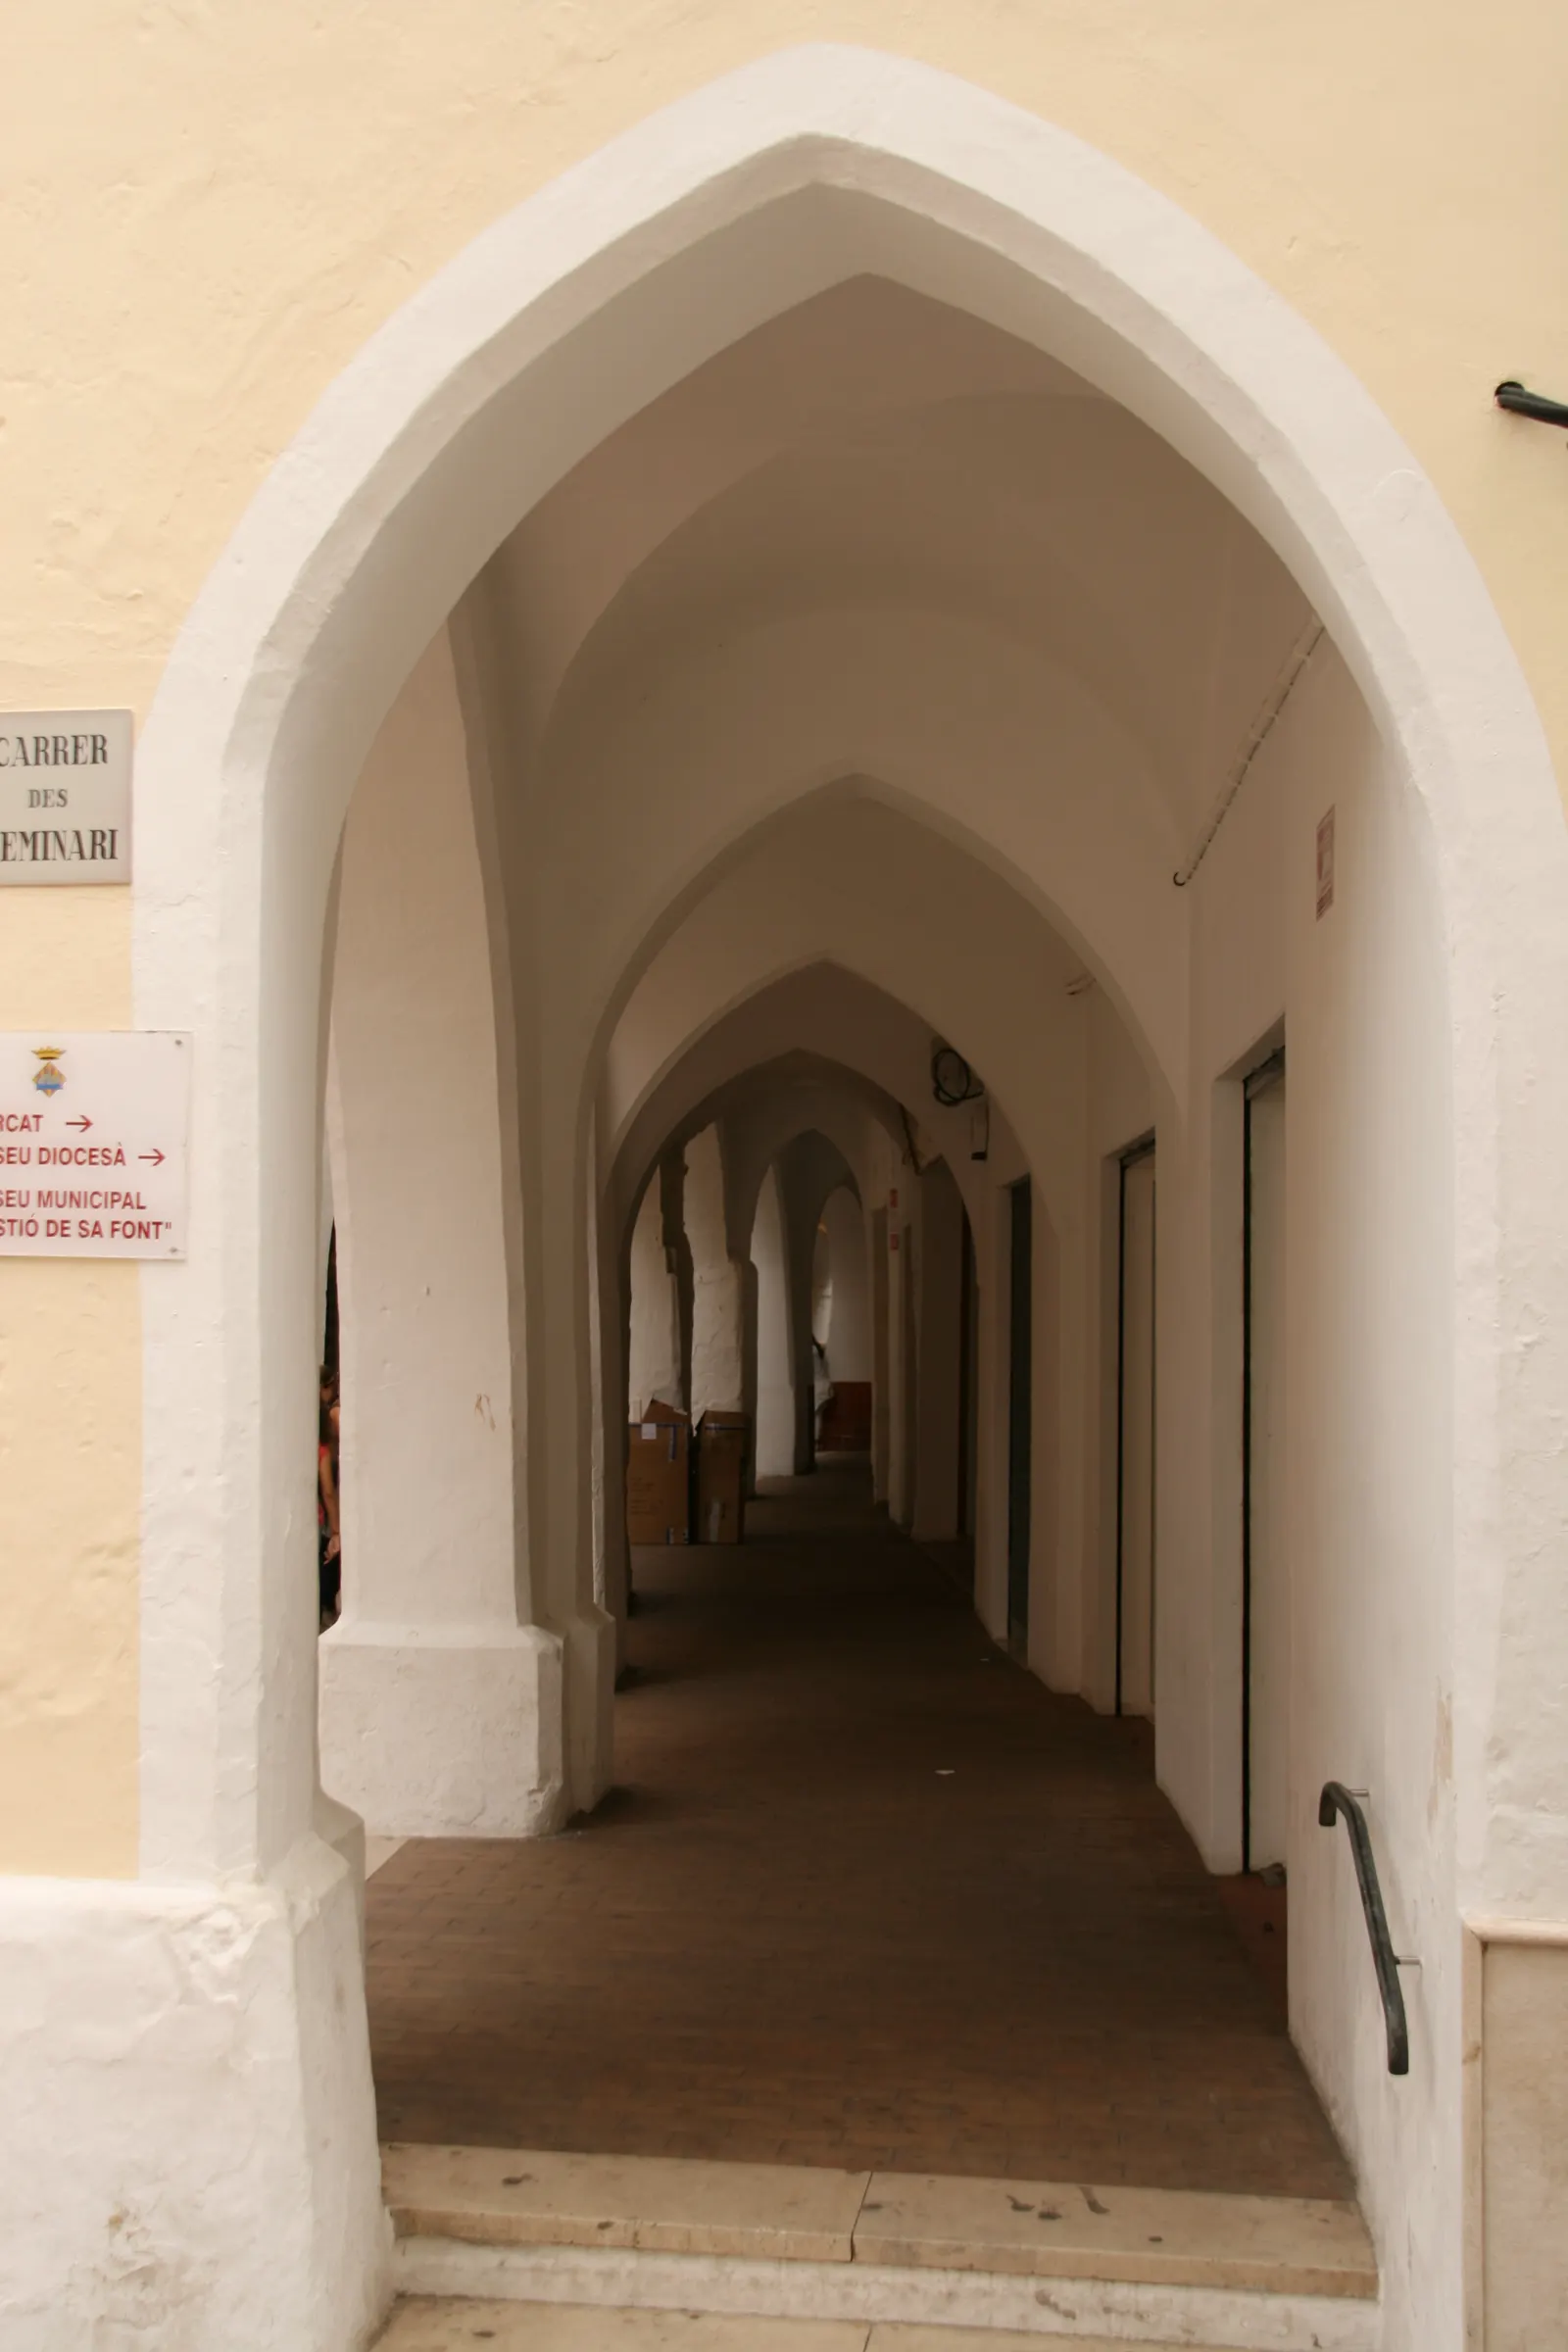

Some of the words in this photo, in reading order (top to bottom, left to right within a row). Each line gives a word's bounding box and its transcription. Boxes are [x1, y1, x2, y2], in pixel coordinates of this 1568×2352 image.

[27, 788, 69, 808] DES
[38, 1142, 126, 1166] DIOCESÀ
[37, 1191, 147, 1210] MUNICIPAL
[45, 1220, 72, 1238] DE
[78, 1220, 104, 1239] SA
[110, 1221, 172, 1241] FONT"
